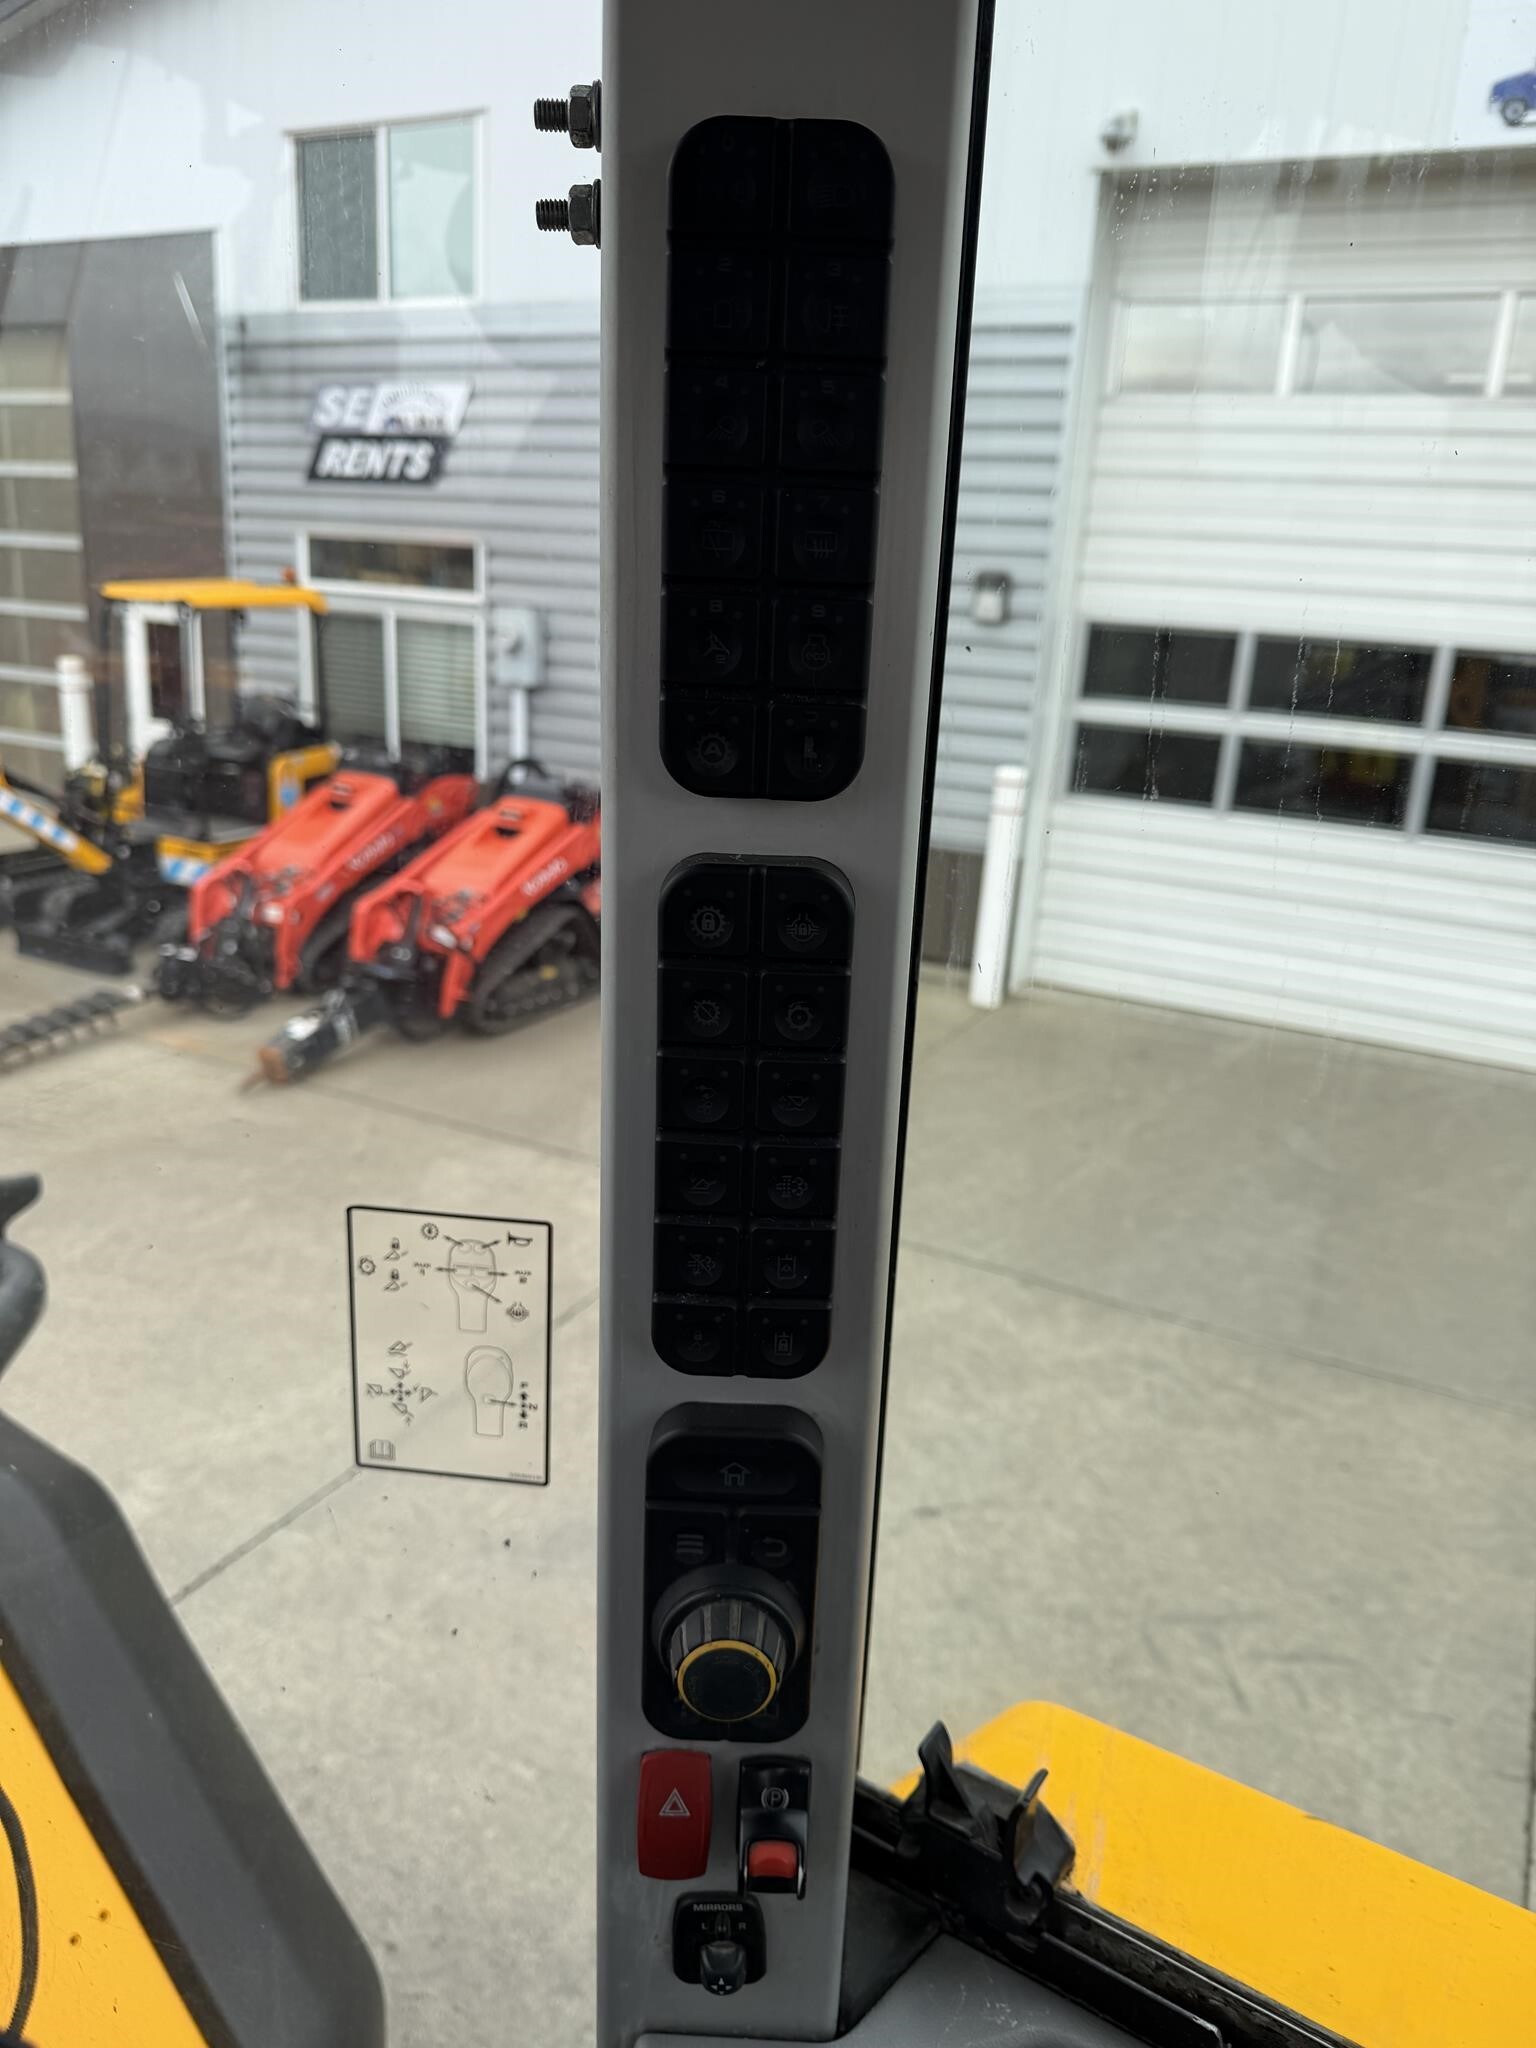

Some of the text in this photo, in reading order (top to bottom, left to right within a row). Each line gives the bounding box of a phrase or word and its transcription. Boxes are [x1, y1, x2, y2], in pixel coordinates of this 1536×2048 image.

[315, 438, 436, 480] RENTS
[711, 490, 727, 504] 6
[769, 1791, 782, 1807] P
[692, 1903, 744, 1912] MIRRORS
[701, 1922, 747, 1931] L R
